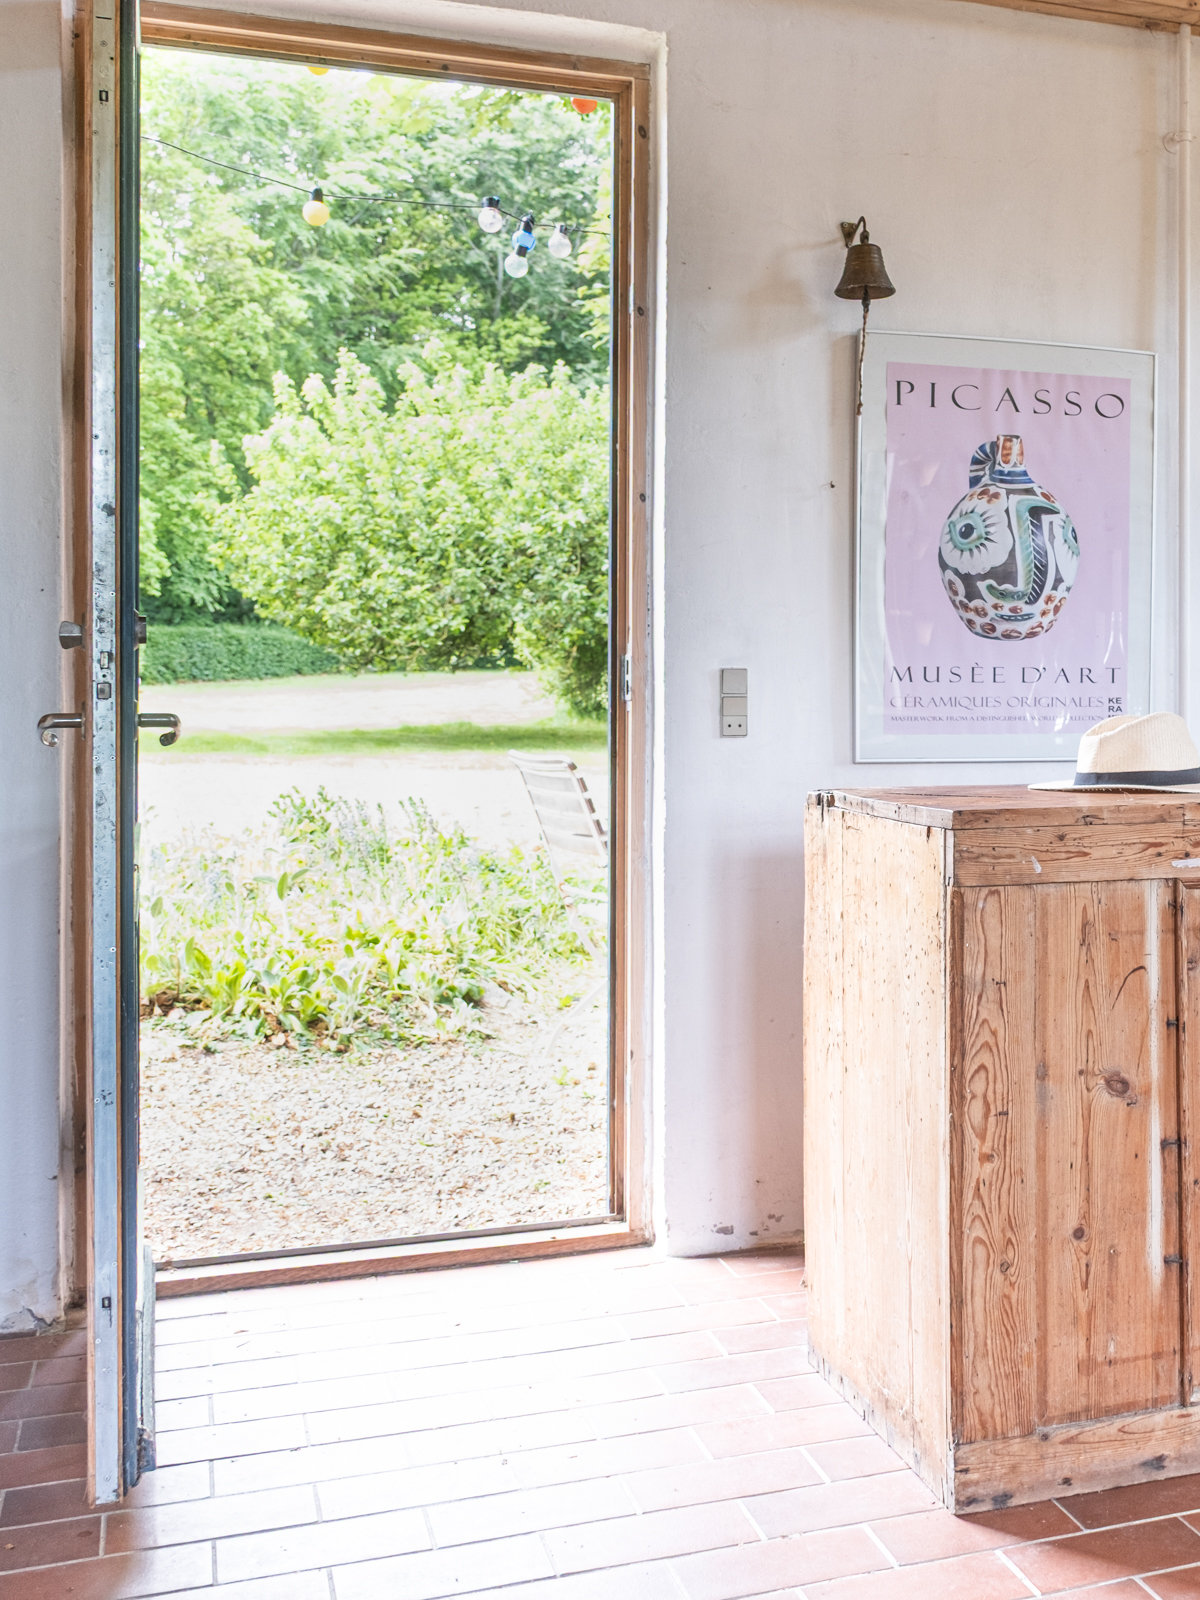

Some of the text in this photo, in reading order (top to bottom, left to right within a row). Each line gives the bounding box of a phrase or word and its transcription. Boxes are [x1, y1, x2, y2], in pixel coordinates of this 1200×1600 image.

[895, 379, 1125, 419] PICASSO
[890, 661, 1006, 684] MUSÈE
[1006, 695, 1105, 708] ORIGINALES
